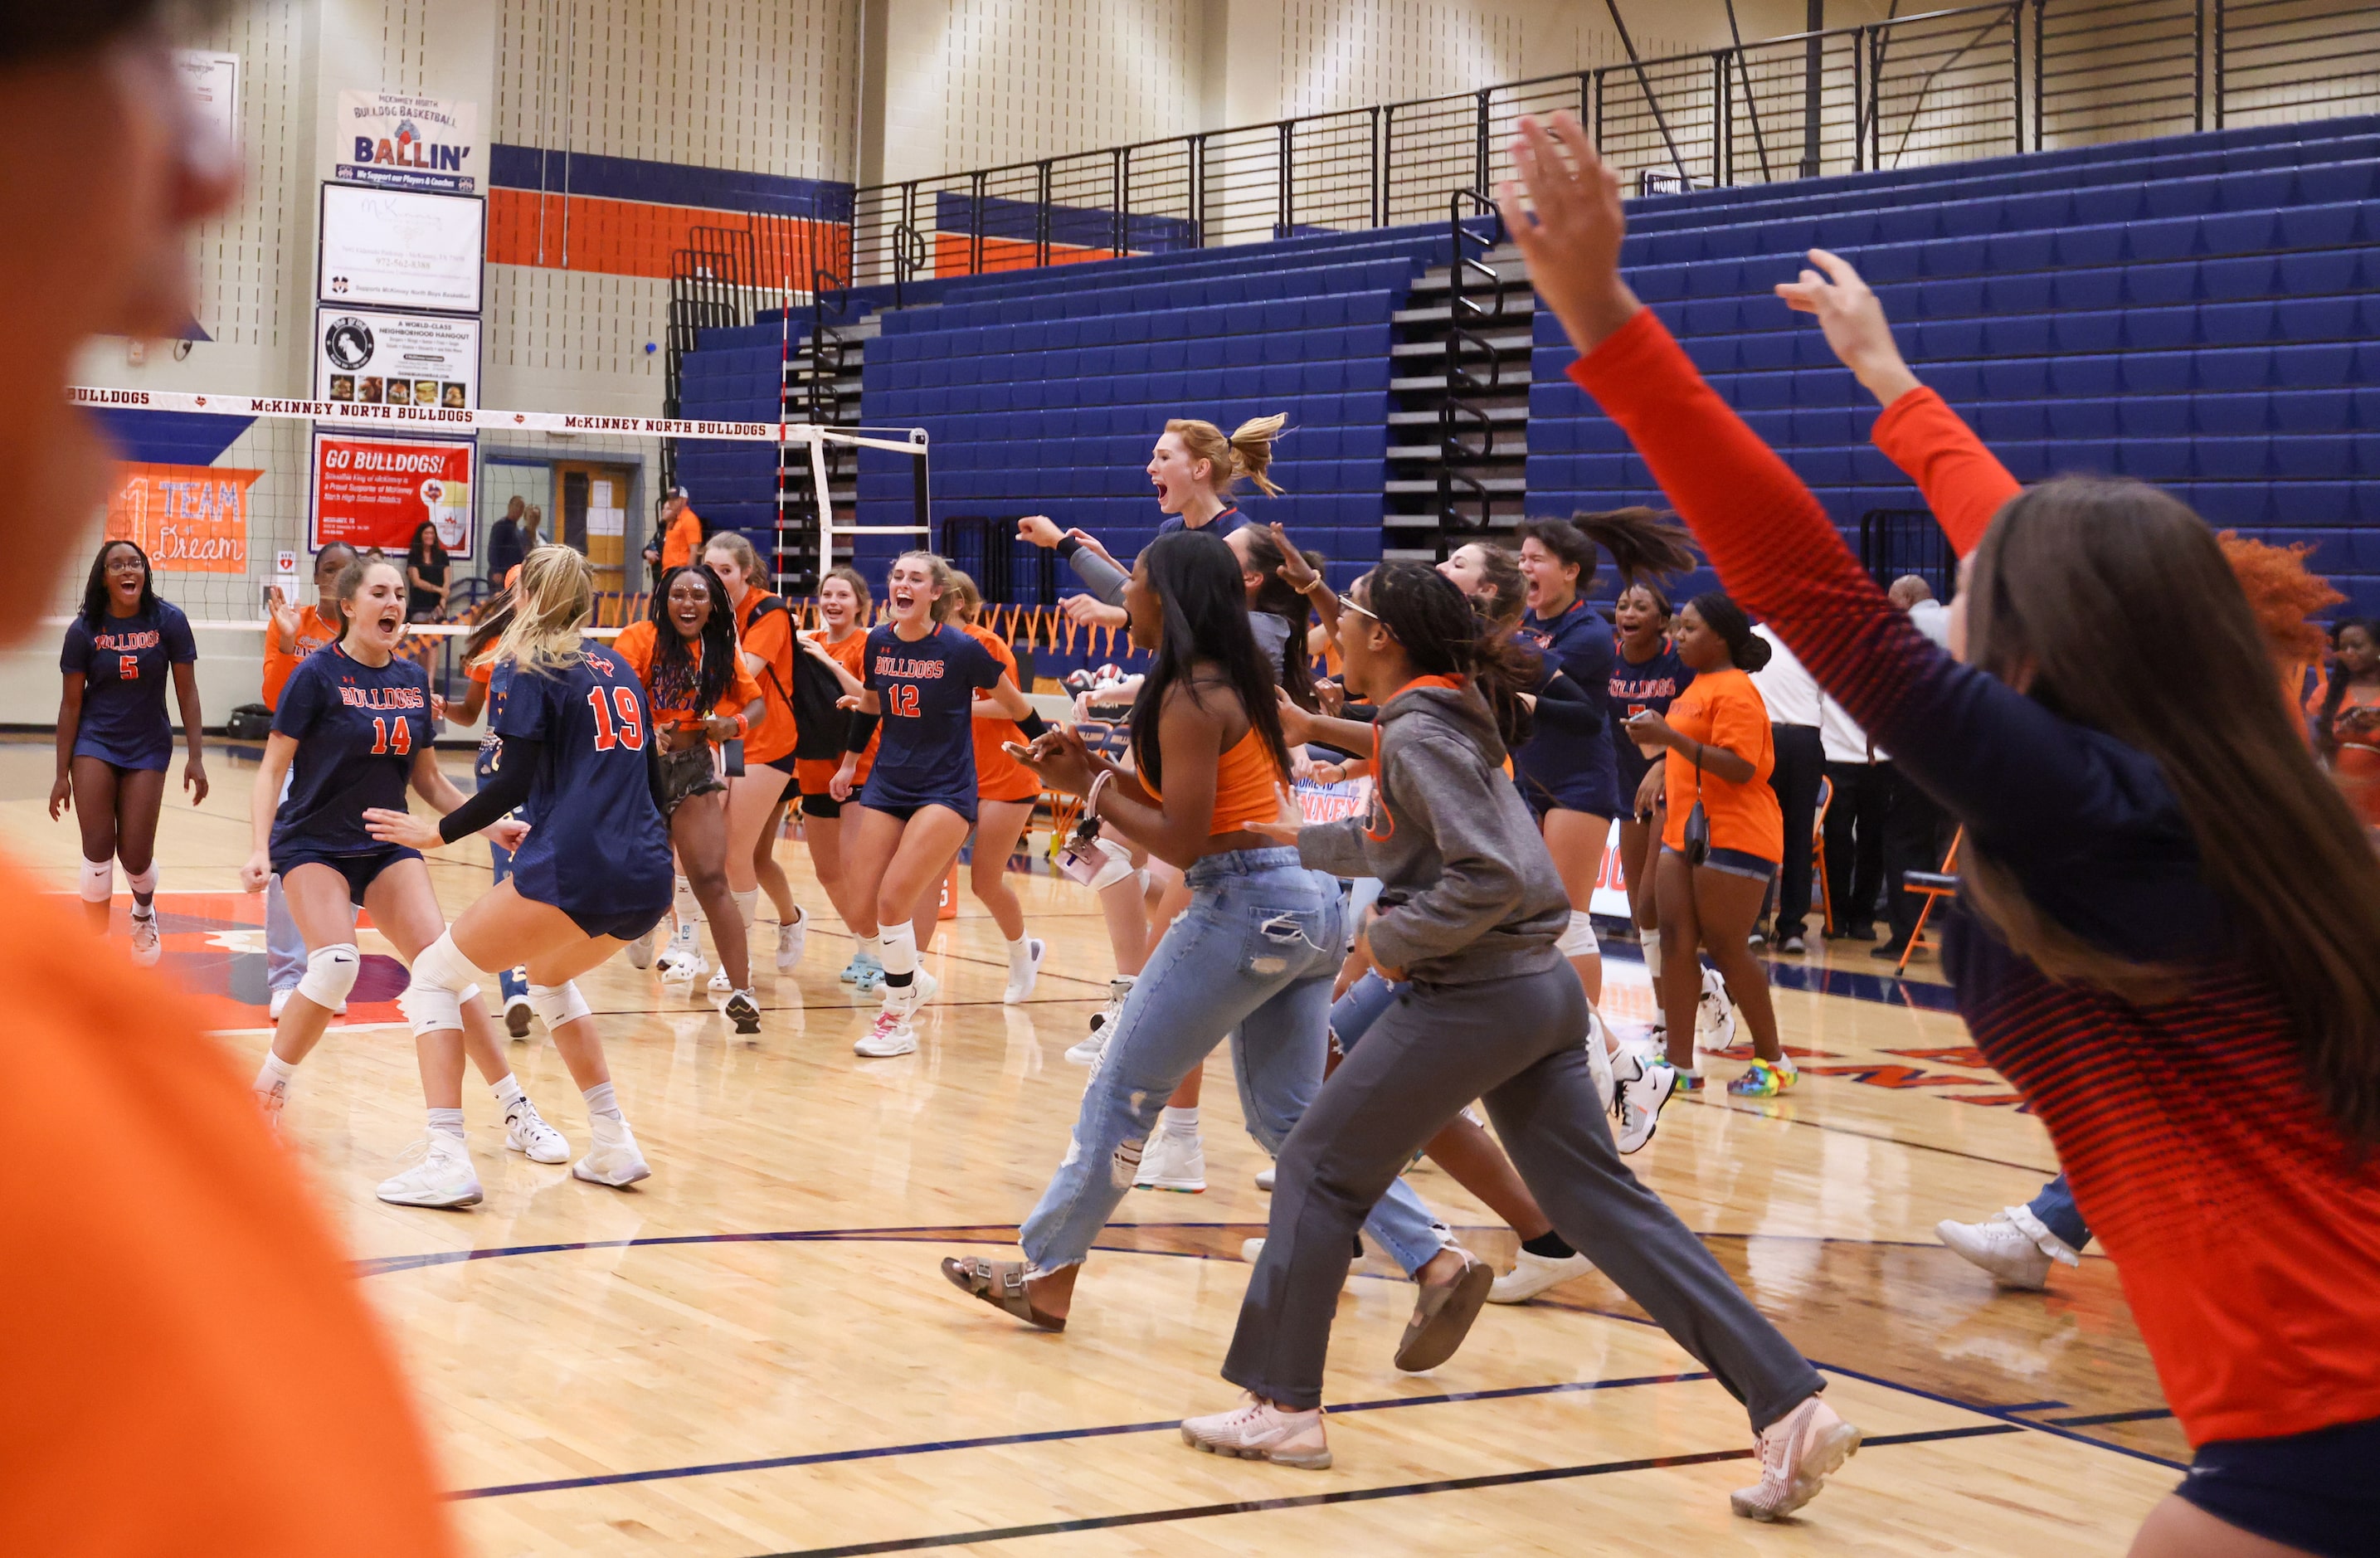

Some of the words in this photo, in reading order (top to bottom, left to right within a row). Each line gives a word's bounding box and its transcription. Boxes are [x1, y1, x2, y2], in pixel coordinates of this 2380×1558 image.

[416, 100, 438, 108] NORTH
[354, 106, 397, 118] BULLDOG
[400, 106, 457, 128] BASKETBALL
[355, 136, 470, 171] BALLIN'
[357, 169, 367, 178] We
[367, 171, 392, 182] Support
[392, 174, 403, 183] our
[403, 175, 425, 185] Players
[425, 177, 431, 185] &
[431, 178, 455, 187] Coaches
[379, 328, 434, 337] NEIGHBORHOOD
[436, 331, 470, 340] HANGOUT
[405, 322, 452, 330] WORLD-CLASS
[66, 388, 150, 405] BULLDOGS
[251, 399, 333, 415] McKINNEY
[340, 403, 392, 419] NORTH
[397, 407, 473, 423] BULLDOGS
[565, 416, 640, 431] McKINNEY
[645, 420, 693, 433] NORTH
[698, 422, 767, 436] BULLDOGS
[325, 450, 350, 470] GO
[353, 451, 445, 475] BULLDOGS!
[159, 481, 241, 523] TEAM
[151, 523, 244, 562] Dream
[119, 655, 139, 680] 5
[874, 655, 945, 679] BULLDOGS
[338, 686, 425, 710] BULLDOGS
[888, 684, 921, 718] 12
[587, 685, 644, 752] 19
[371, 715, 411, 755] 14
